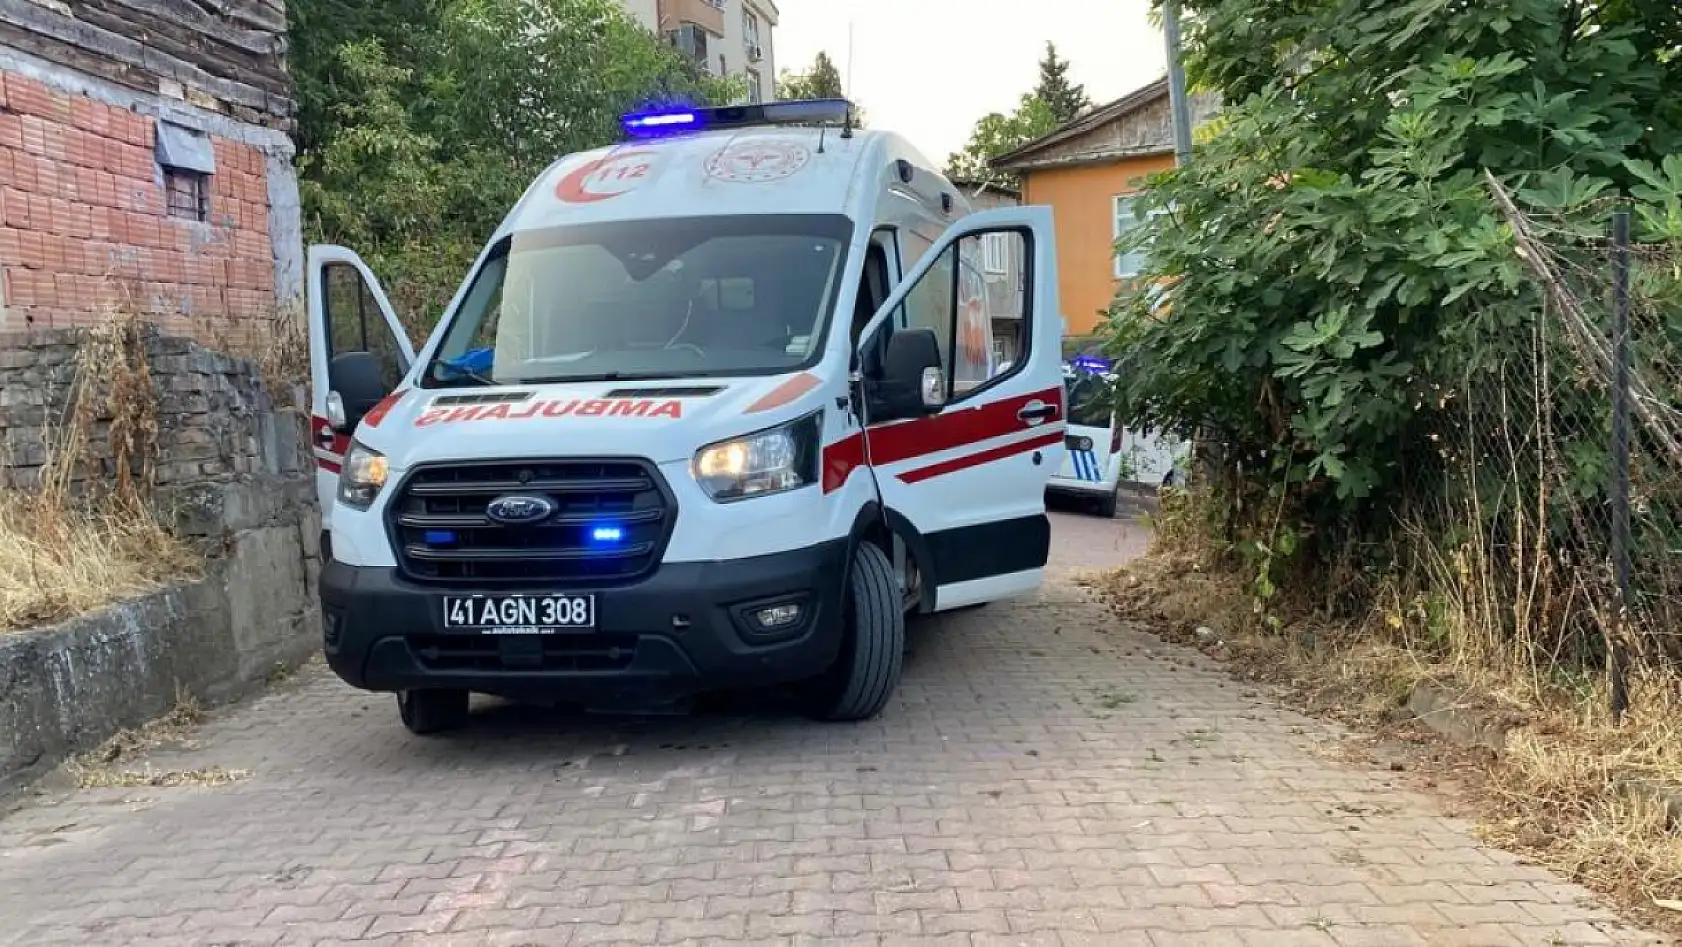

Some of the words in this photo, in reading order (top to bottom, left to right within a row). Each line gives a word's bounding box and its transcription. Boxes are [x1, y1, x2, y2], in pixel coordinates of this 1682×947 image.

[598, 163, 649, 181] 112
[499, 501, 536, 516] Ford
[450, 598, 474, 625] 41
[480, 598, 536, 625] AGN
[541, 597, 587, 624] 308
